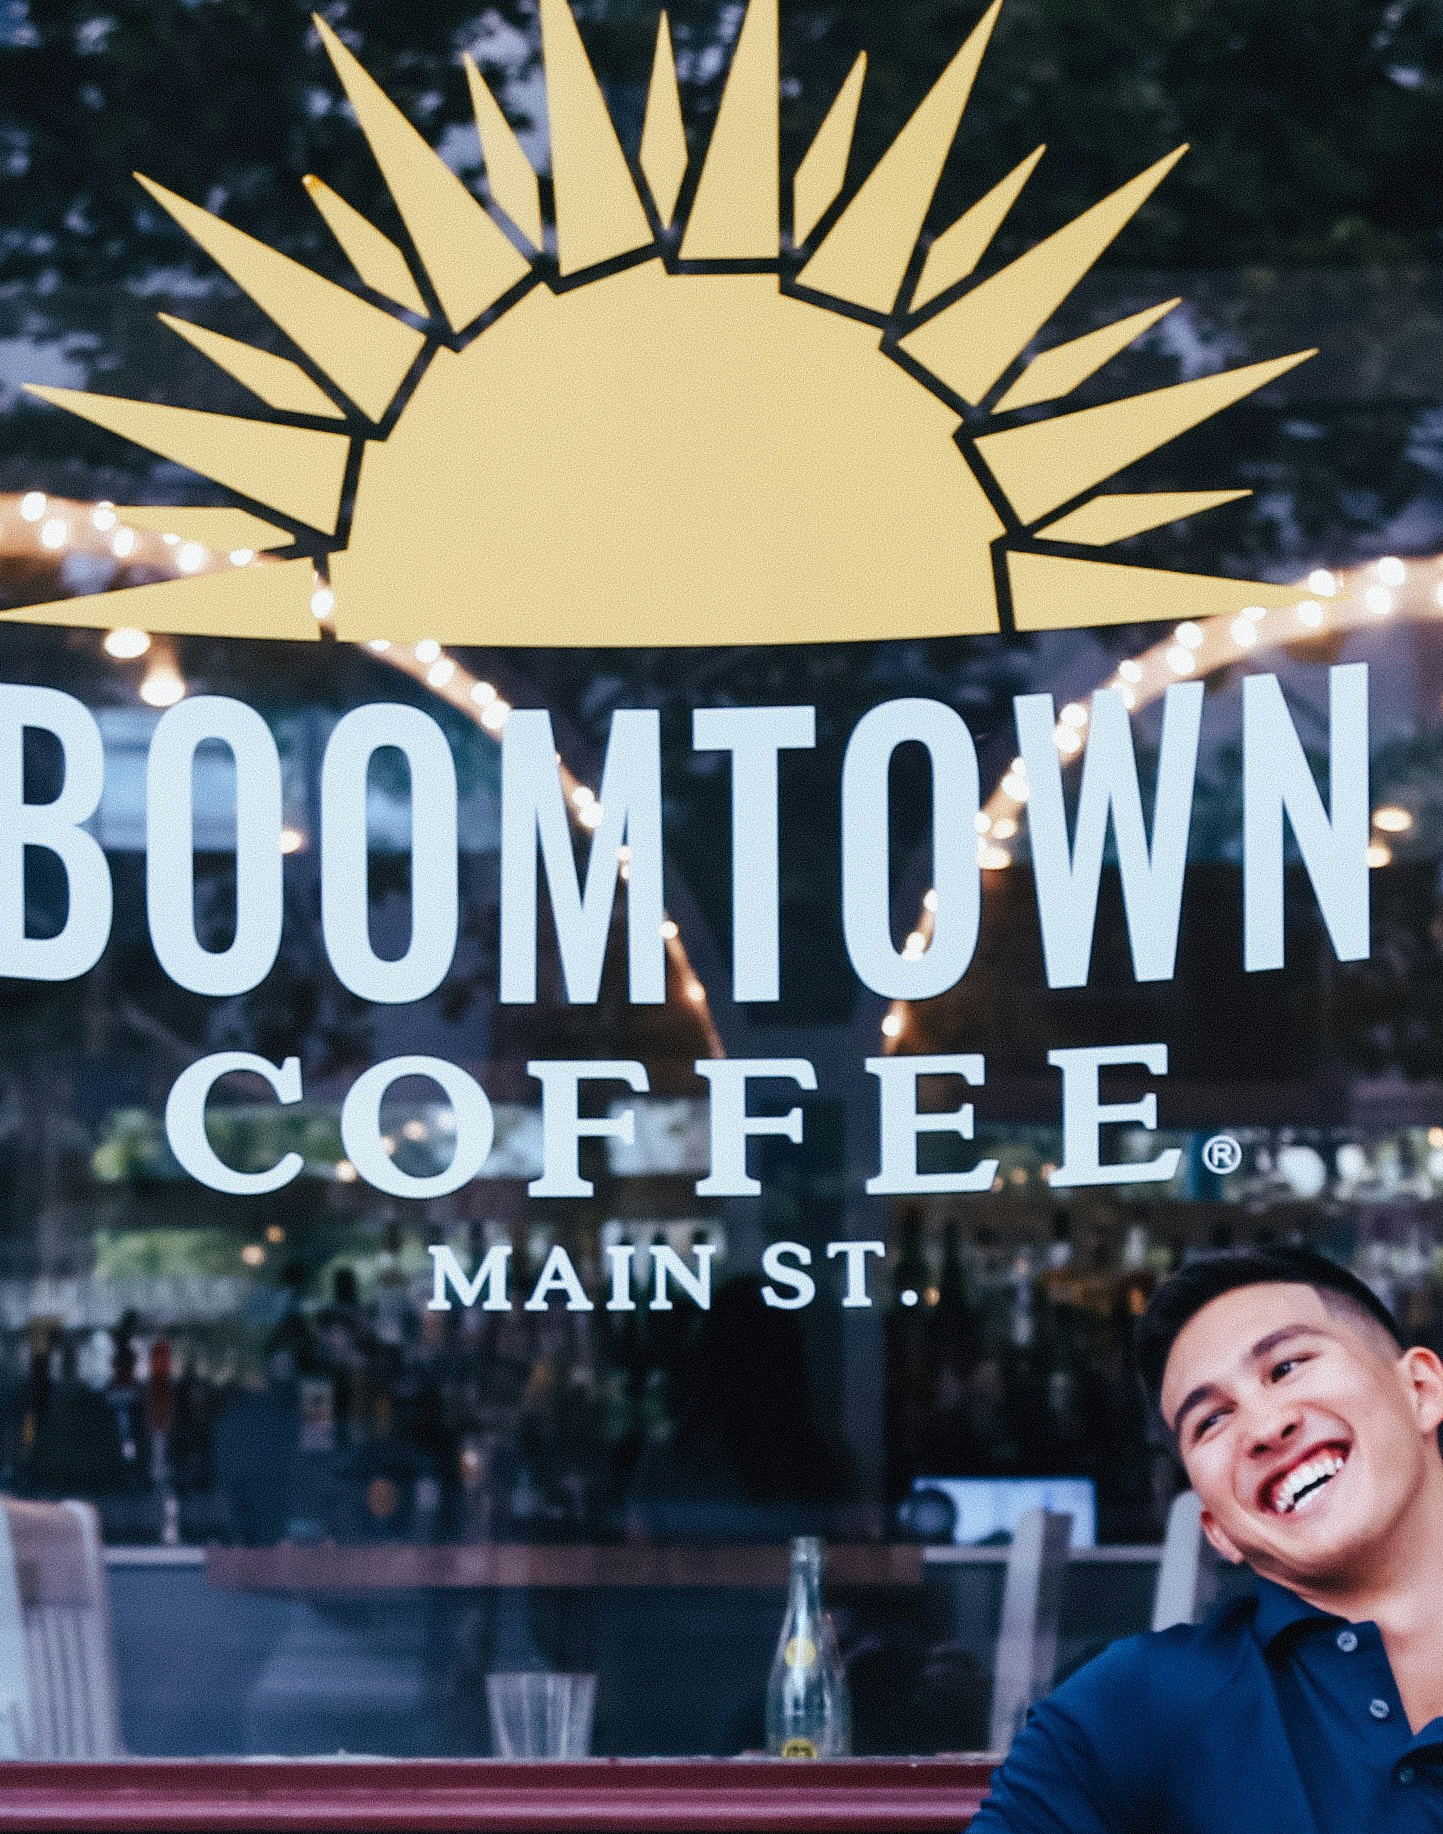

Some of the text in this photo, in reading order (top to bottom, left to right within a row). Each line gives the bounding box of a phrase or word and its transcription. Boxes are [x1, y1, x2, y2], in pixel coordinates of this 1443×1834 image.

[164, 1043, 1182, 1198] COFFEE
[426, 1239, 922, 1312] MAIN ST.
